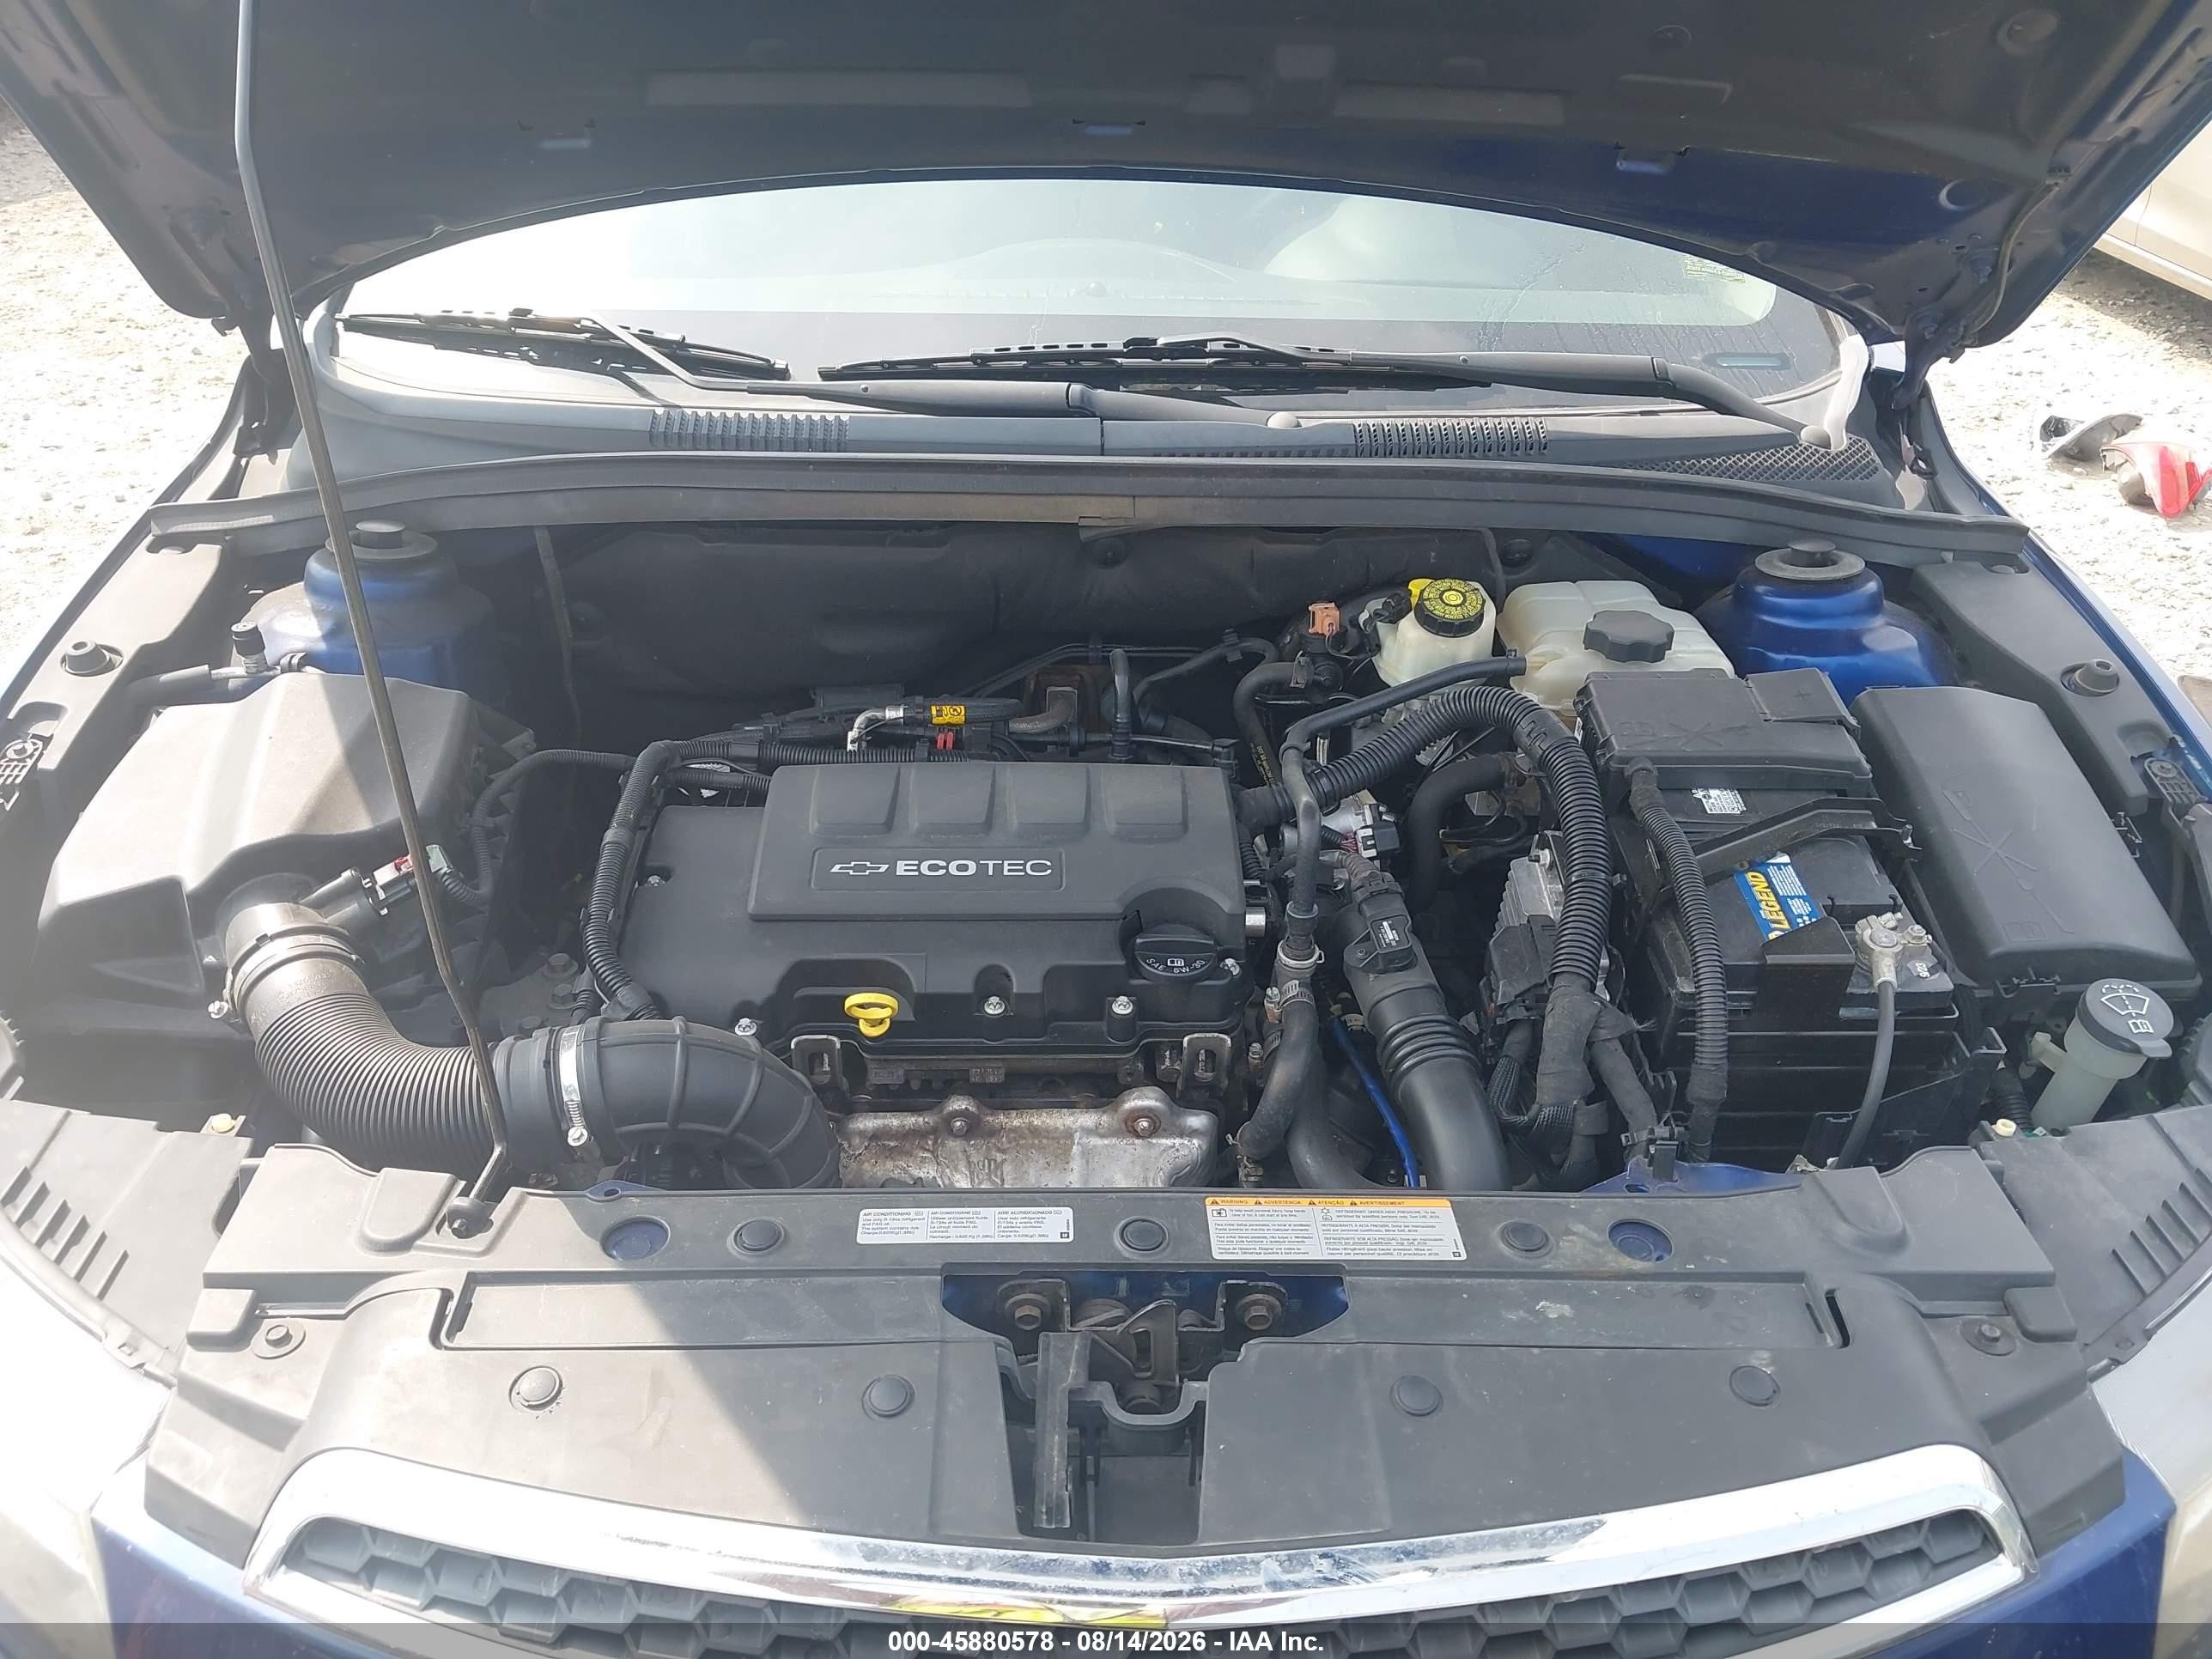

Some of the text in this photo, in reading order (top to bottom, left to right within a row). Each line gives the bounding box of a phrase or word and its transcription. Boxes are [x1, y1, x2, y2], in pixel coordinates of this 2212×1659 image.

[896, 859, 1053, 876] ECOTEC
[1146, 958, 1206, 974] SAE 5W-30
